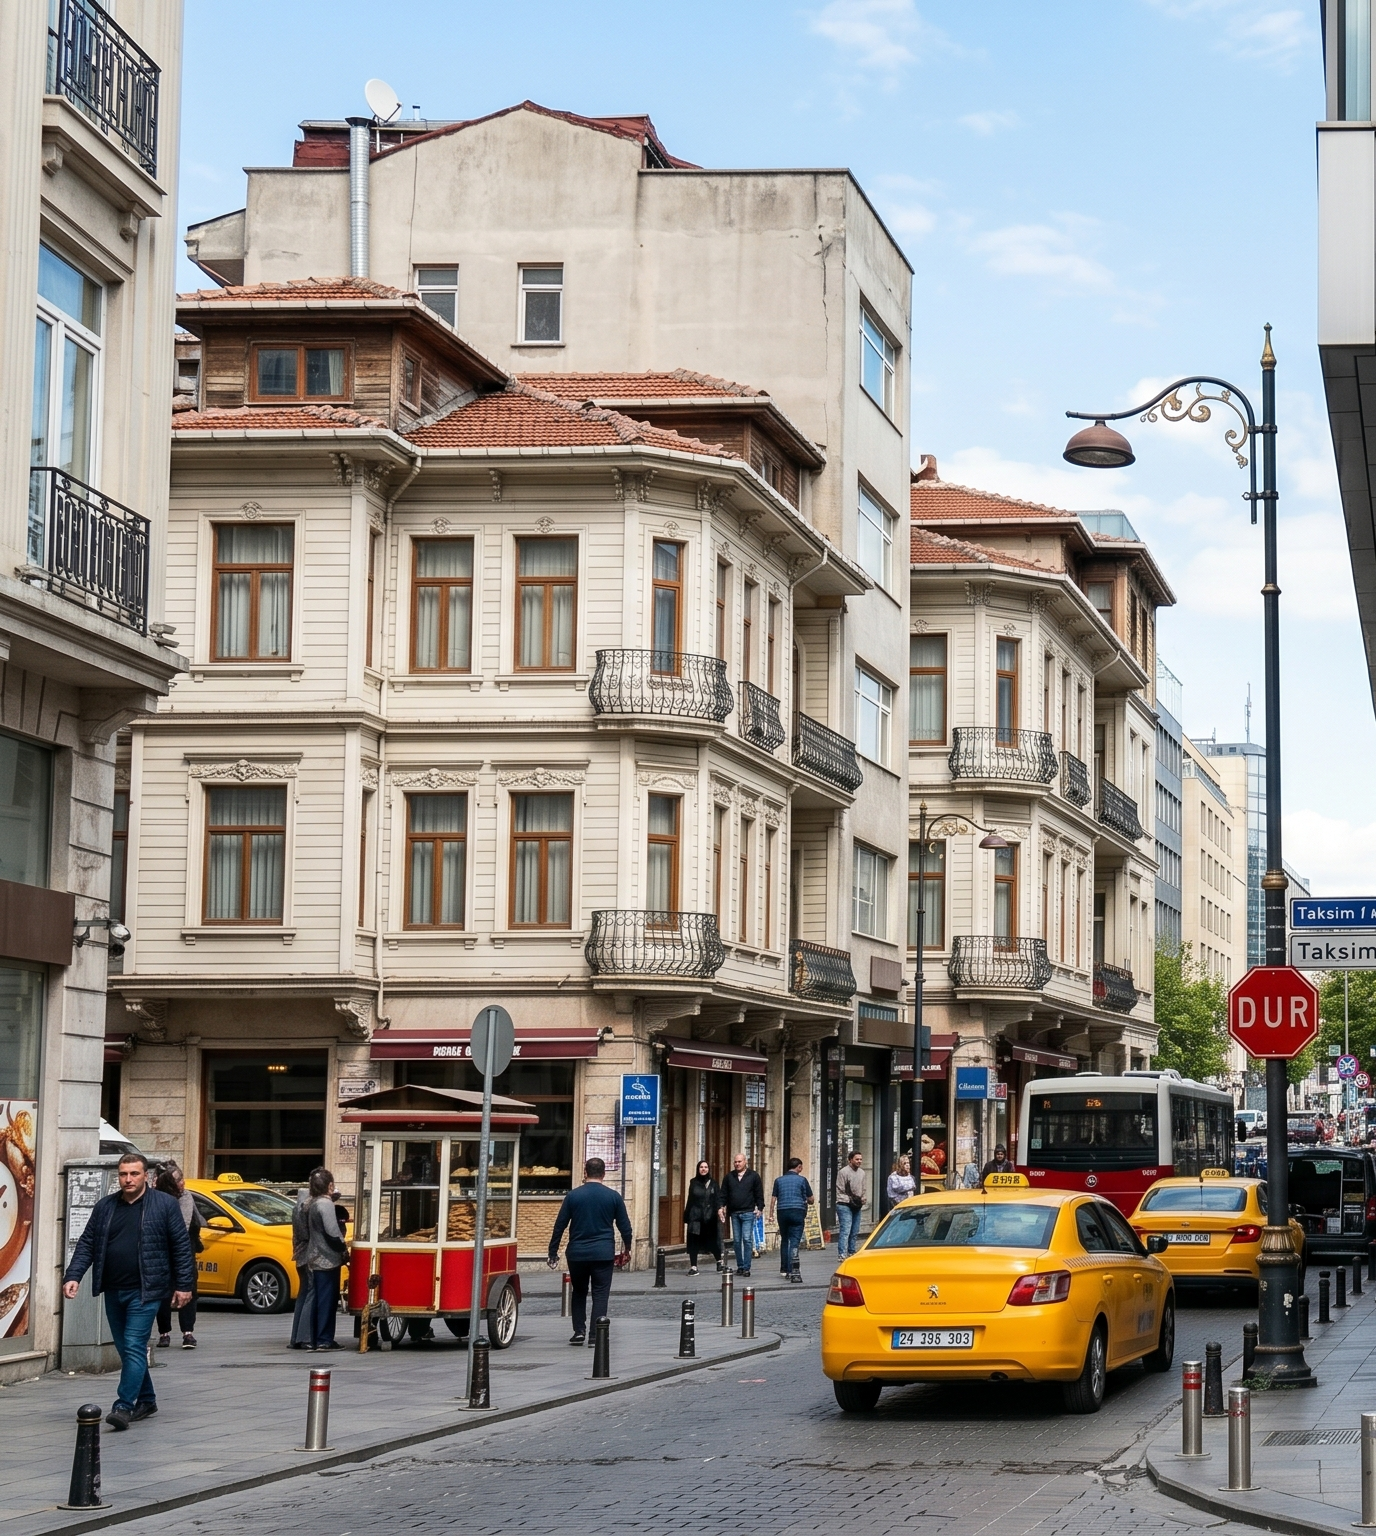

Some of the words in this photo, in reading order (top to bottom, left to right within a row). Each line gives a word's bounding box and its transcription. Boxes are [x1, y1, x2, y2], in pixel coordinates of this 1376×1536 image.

[1297, 906, 1355, 920] Taksim
[1238, 996, 1309, 1028] DUR
[899, 1332, 914, 1345] 24
[947, 1332, 970, 1345] 303
